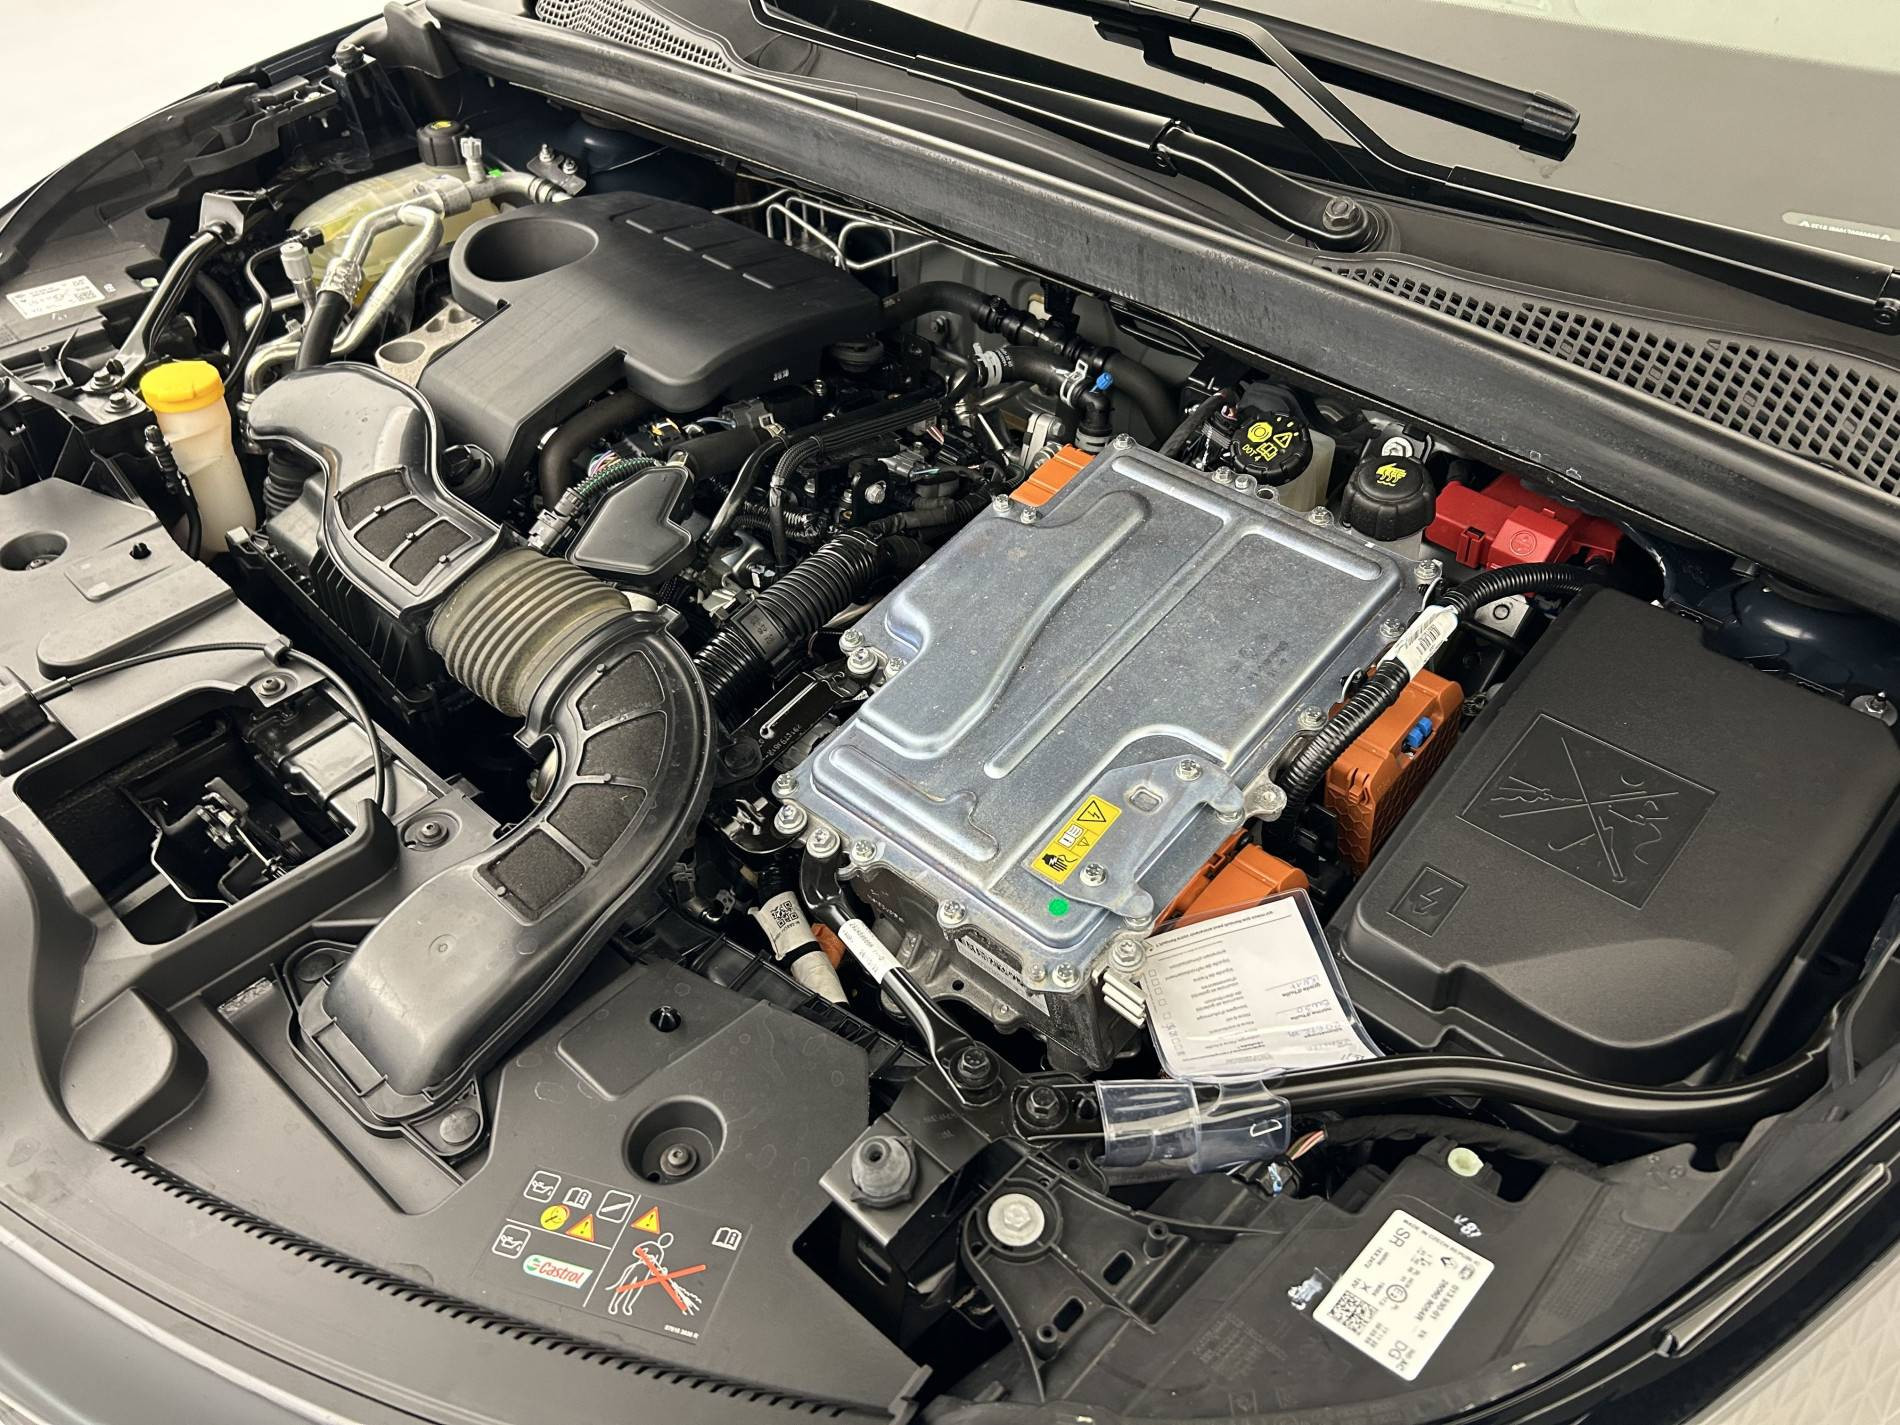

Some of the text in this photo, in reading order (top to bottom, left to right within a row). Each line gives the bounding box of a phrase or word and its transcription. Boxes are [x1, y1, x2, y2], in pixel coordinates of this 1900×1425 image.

[1241, 443, 1257, 457] DOT
[1388, 1225, 1412, 1249] SR
[538, 1261, 585, 1284] Castrol
[1386, 1338, 1409, 1361] DG
